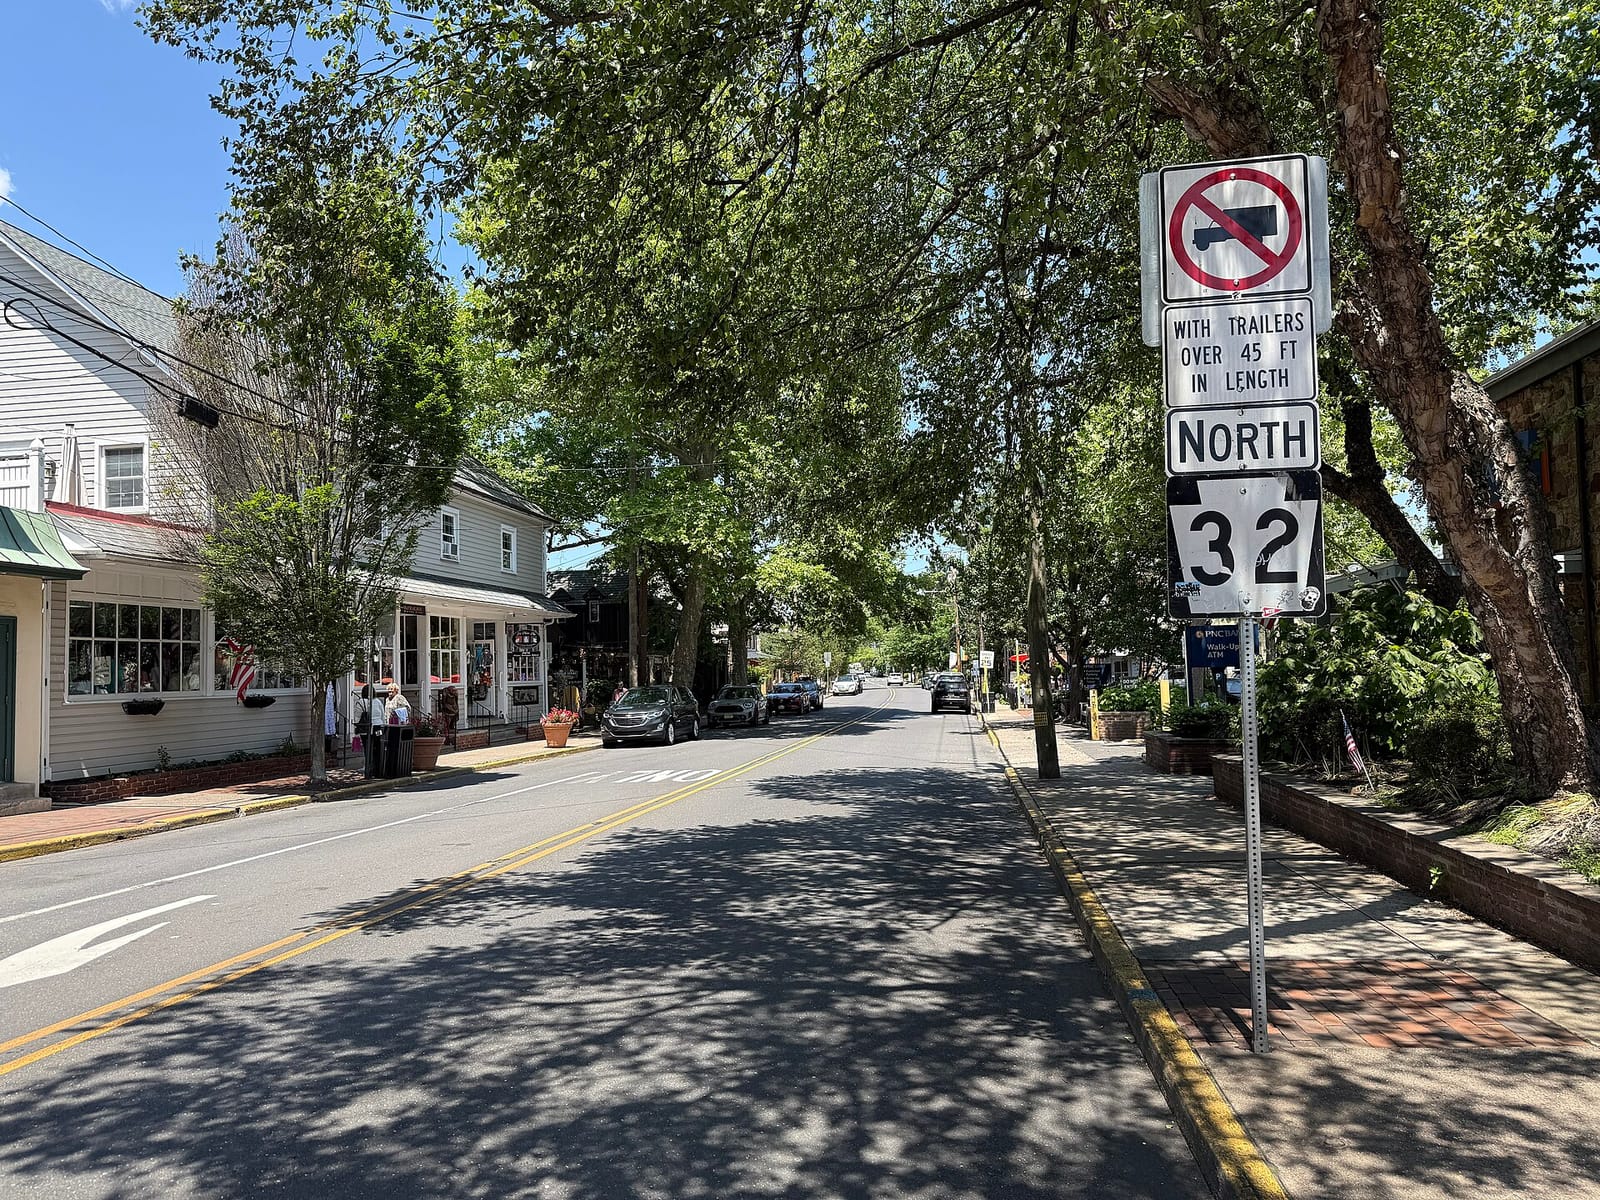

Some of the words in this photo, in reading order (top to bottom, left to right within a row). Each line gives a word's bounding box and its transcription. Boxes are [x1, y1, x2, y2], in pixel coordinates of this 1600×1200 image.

[1174, 318, 1211, 339] WITH
[1228, 313, 1304, 337] TRAILERS
[1181, 345, 1222, 366] OVER
[1241, 342, 1262, 362] 45
[1280, 340, 1298, 360] FT
[1192, 373, 1207, 393] IN
[1226, 369, 1289, 391] LENGTH
[1179, 420, 1306, 463] NORTH
[1190, 508, 1299, 586] 32
[1207, 643, 1240, 652] Walk-Up
